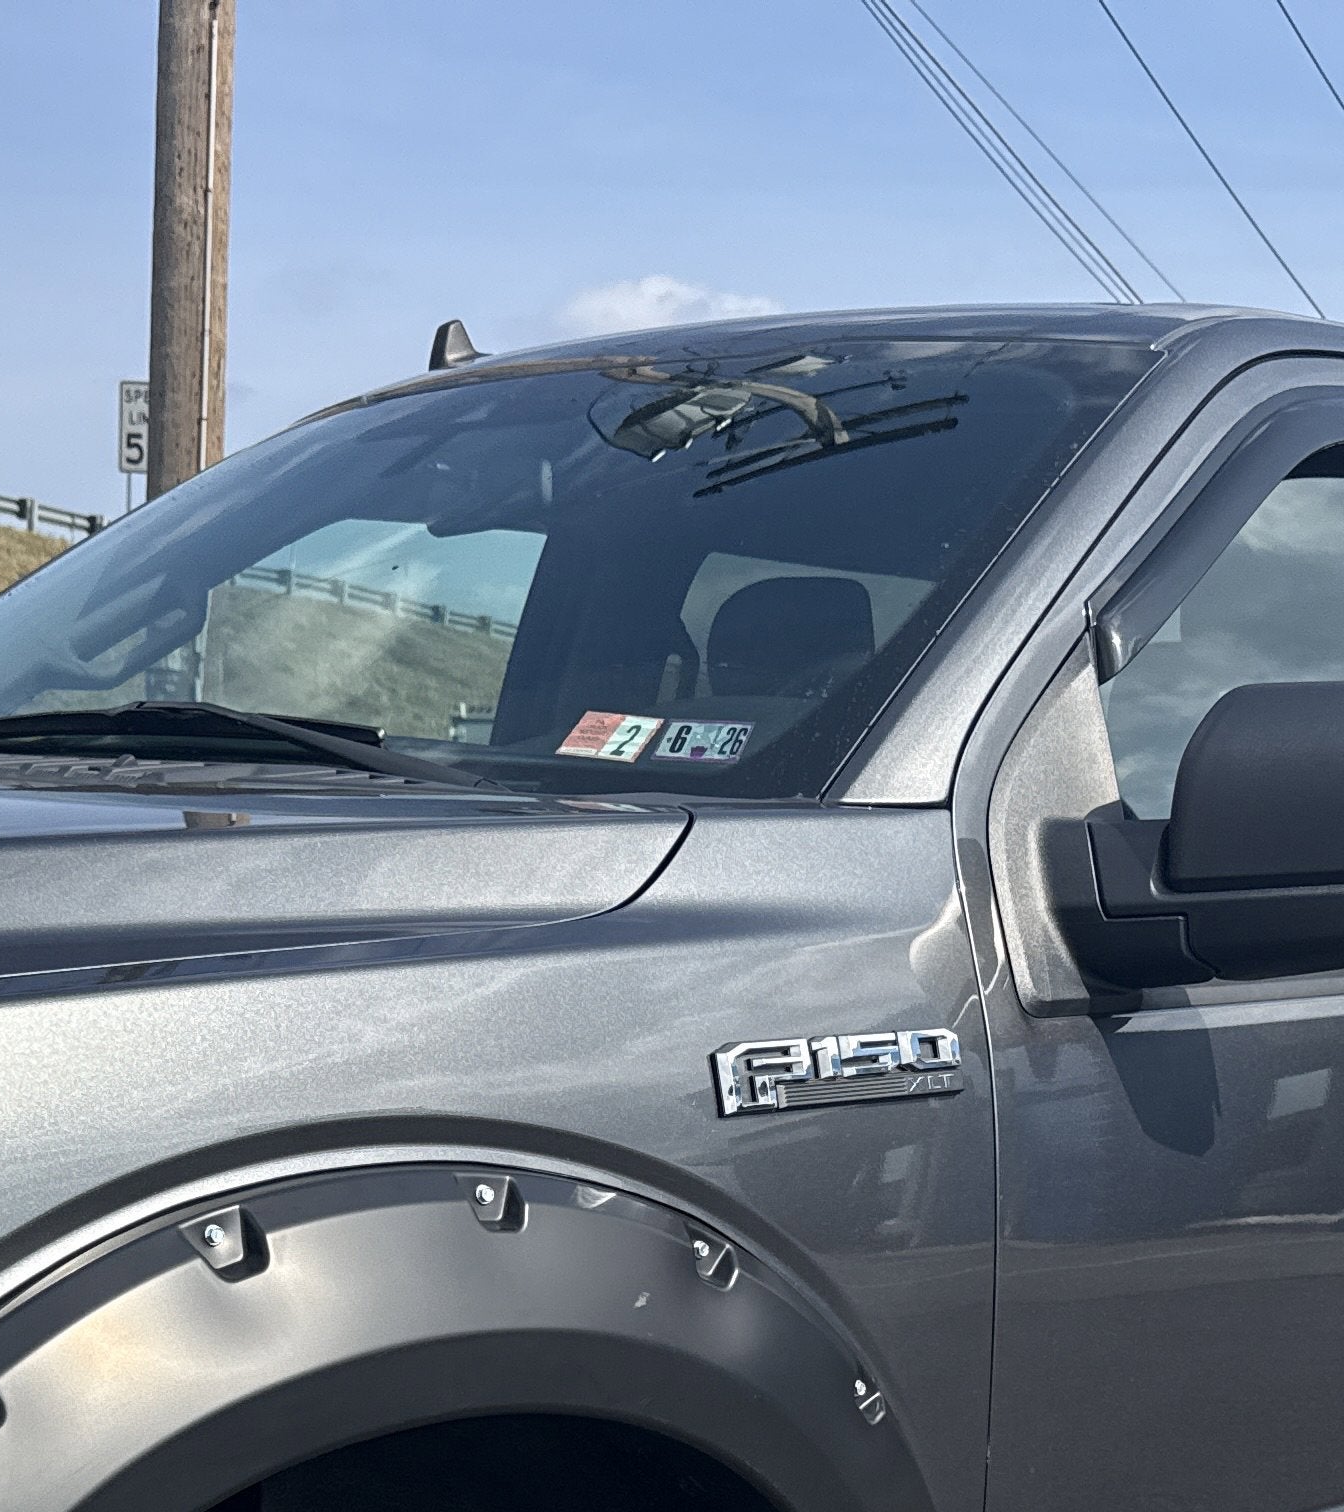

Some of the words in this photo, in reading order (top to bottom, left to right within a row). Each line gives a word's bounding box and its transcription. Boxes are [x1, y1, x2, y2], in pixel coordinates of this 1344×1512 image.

[126, 433, 144, 465] 5
[610, 725, 642, 756] 2
[717, 727, 749, 755] 26
[909, 1073, 954, 1092] XLT
